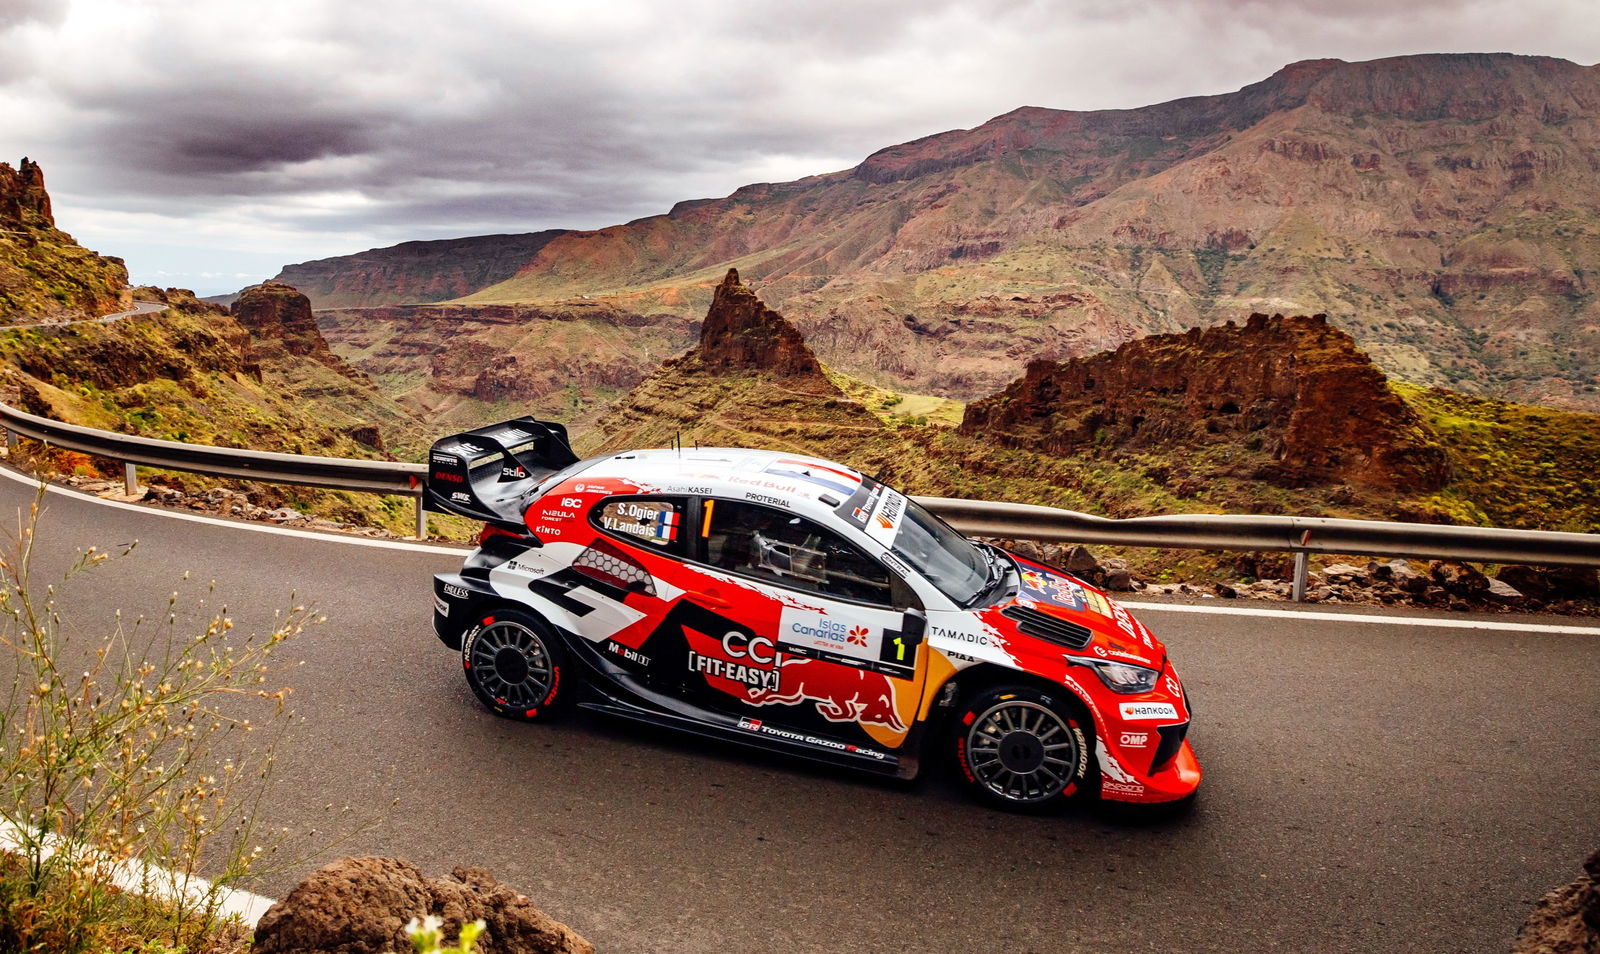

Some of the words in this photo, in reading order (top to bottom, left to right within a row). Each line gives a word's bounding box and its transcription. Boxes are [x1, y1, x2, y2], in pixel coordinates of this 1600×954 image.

[435, 472, 464, 483] DENSO
[502, 466, 526, 478] Stilo
[745, 492, 791, 508] PROTERIAL
[617, 503, 659, 521] S.Ogier
[701, 499, 715, 538] 1
[603, 516, 656, 538] V.Landais
[518, 563, 545, 575] Microsoft
[443, 584, 469, 598] ENDLESS
[792, 622, 846, 643] Canarias
[819, 618, 847, 632] Islas
[931, 626, 988, 646] TAMADIC
[608, 641, 638, 661] Mobil
[893, 637, 905, 660] 1
[947, 650, 975, 662] PIAA
[761, 726, 804, 741] TOYOTA
[805, 736, 845, 750] GAZOO
[846, 744, 885, 759] Racing
[1119, 735, 1148, 745] OMP
